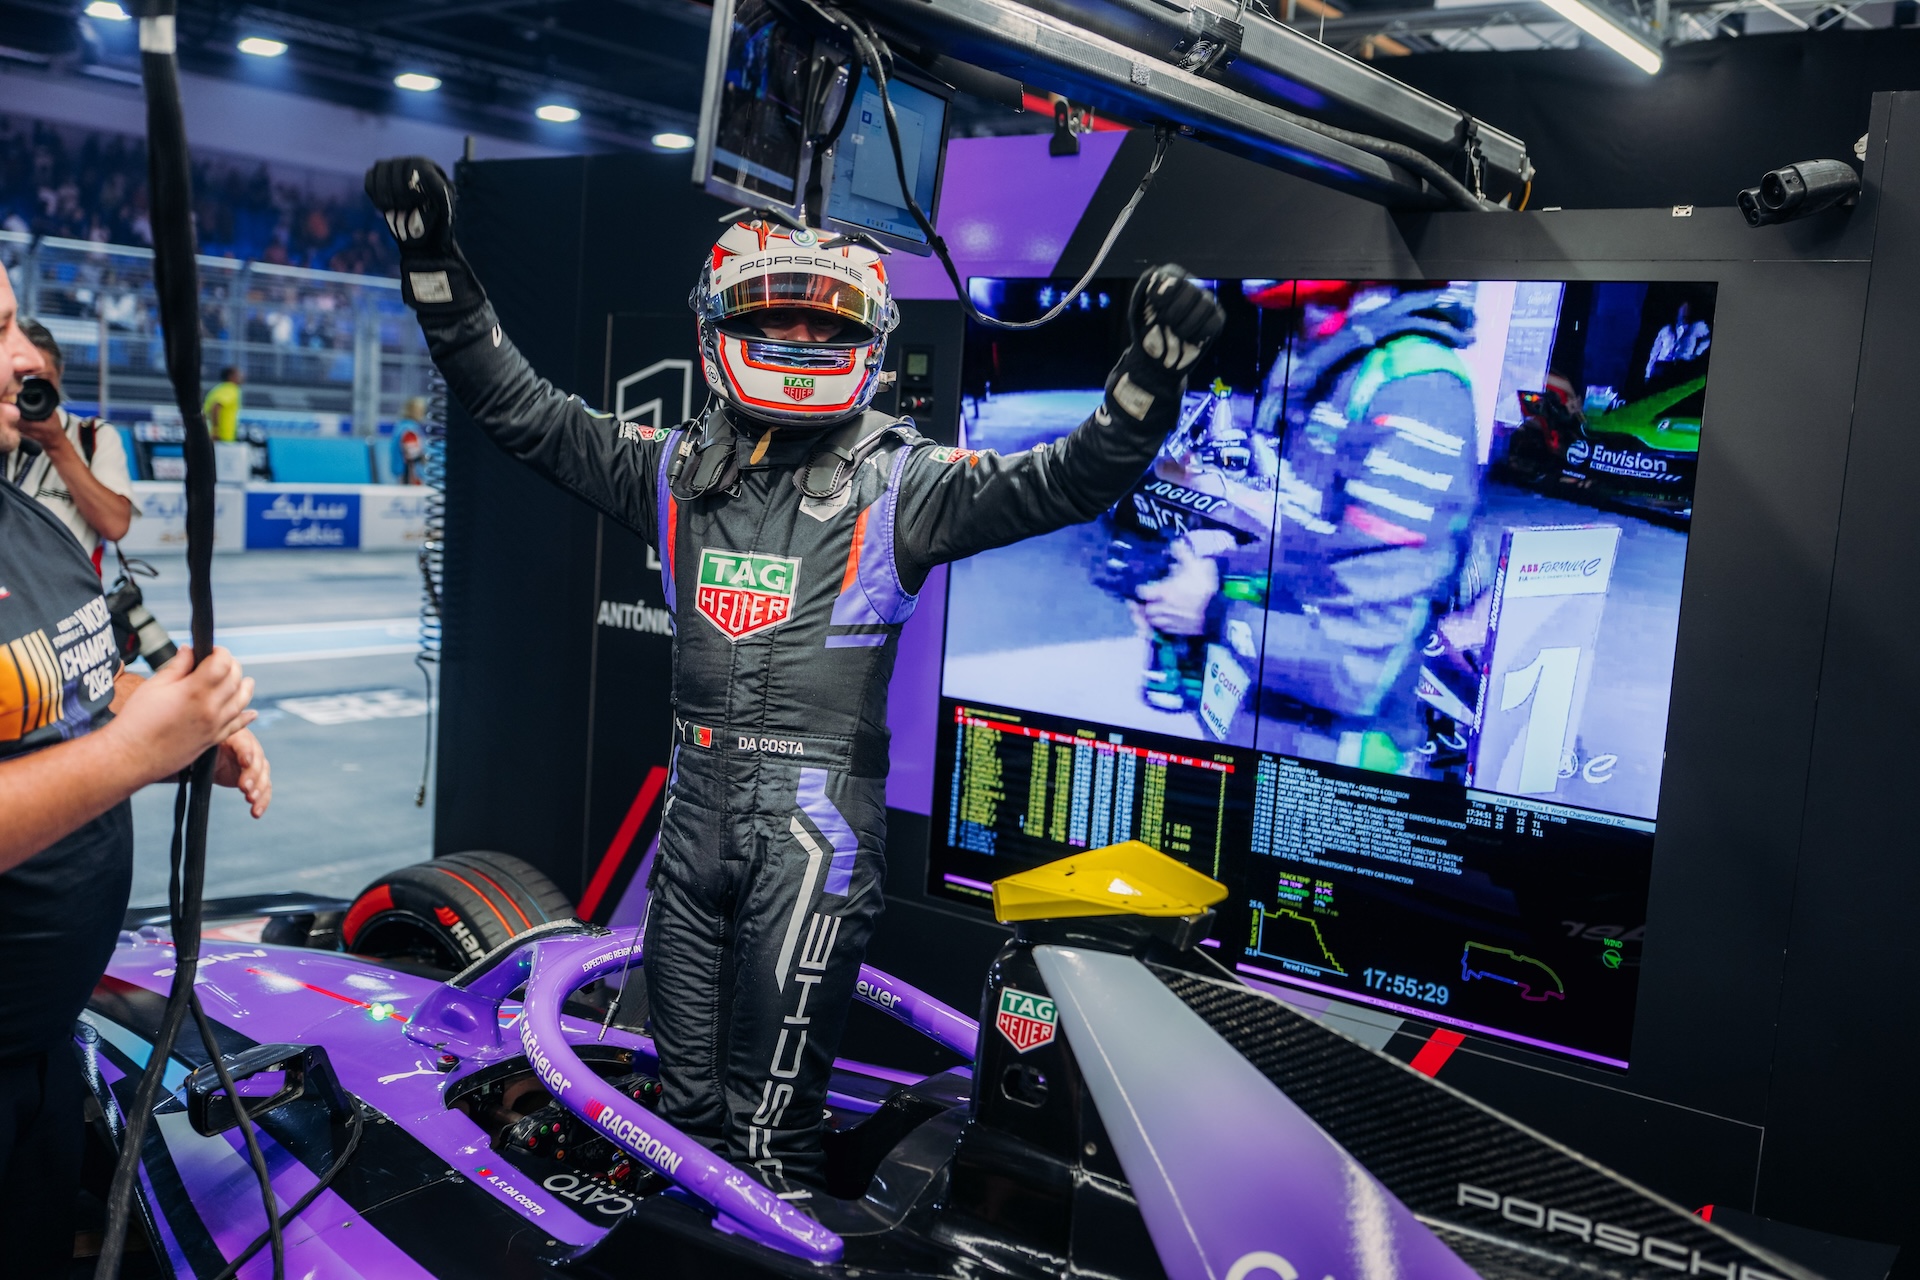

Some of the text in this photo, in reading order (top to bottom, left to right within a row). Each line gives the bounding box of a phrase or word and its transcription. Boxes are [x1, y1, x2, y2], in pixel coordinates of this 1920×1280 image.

[738, 255, 863, 281] PORSCHE
[784, 376, 814, 387] TAG
[784, 387, 813, 402] HEUER
[1592, 445, 1667, 472] Envision
[709, 556, 787, 590] TAG
[1520, 564, 1538, 574] ABB
[701, 589, 786, 634] HEUER
[83, 660, 114, 702] 2025
[1500, 646, 1582, 794] 1
[738, 736, 804, 755] DA COSTA
[1334, 780, 1354, 789] PENALTY
[1358, 784, 1379, 793] CAUSING
[1384, 789, 1409, 798] COLLISION
[1380, 795, 1397, 803] NOTED
[1333, 799, 1352, 808] PENALTY
[1367, 806, 1395, 816] FOLLOWING
[1409, 813, 1435, 823] DIRECTORS
[1466, 809, 1492, 819] 17:34:51
[1516, 818, 1525, 826] 22
[1472, 802, 1567, 824] Time Part Lap Track limits
[1520, 802, 1543, 812] Formula
[1550, 807, 1568, 816] World
[1569, 810, 1611, 825] Championship
[1354, 829, 1371, 837] SAFETY
[1382, 834, 1410, 845] INFRACTION
[1355, 823, 1391, 834] INVESTIGATION
[1395, 830, 1416, 839] CAUSING
[1421, 835, 1446, 845] COLLISION
[1387, 822, 1404, 830] NOTED
[1466, 817, 1491, 828] 17:23:21
[1531, 829, 1543, 837] T11
[1370, 838, 1398, 849] FOLLOWING
[1412, 846, 1436, 856] DIRECTOR
[1371, 845, 1385, 853] TRACK
[1386, 848, 1402, 856] LIMITS
[1371, 851, 1398, 862] FOLLOWING
[1412, 860, 1436, 869] DIRECTOR
[1318, 860, 1353, 872] INVESTIGATION
[1384, 873, 1413, 884] INFRACTION
[1603, 938, 1623, 948] WIND
[582, 952, 614, 972] EXPECTING
[1283, 961, 1299, 972] Period
[1304, 966, 1321, 977] hours
[1363, 967, 1449, 1006] 17:55:29
[1006, 993, 1053, 1020] TAG
[1000, 1014, 1051, 1047] HEUER
[597, 1105, 683, 1175] RACEBORN
[514, 1194, 546, 1216] COSTA
[543, 1174, 634, 1215] CATO
